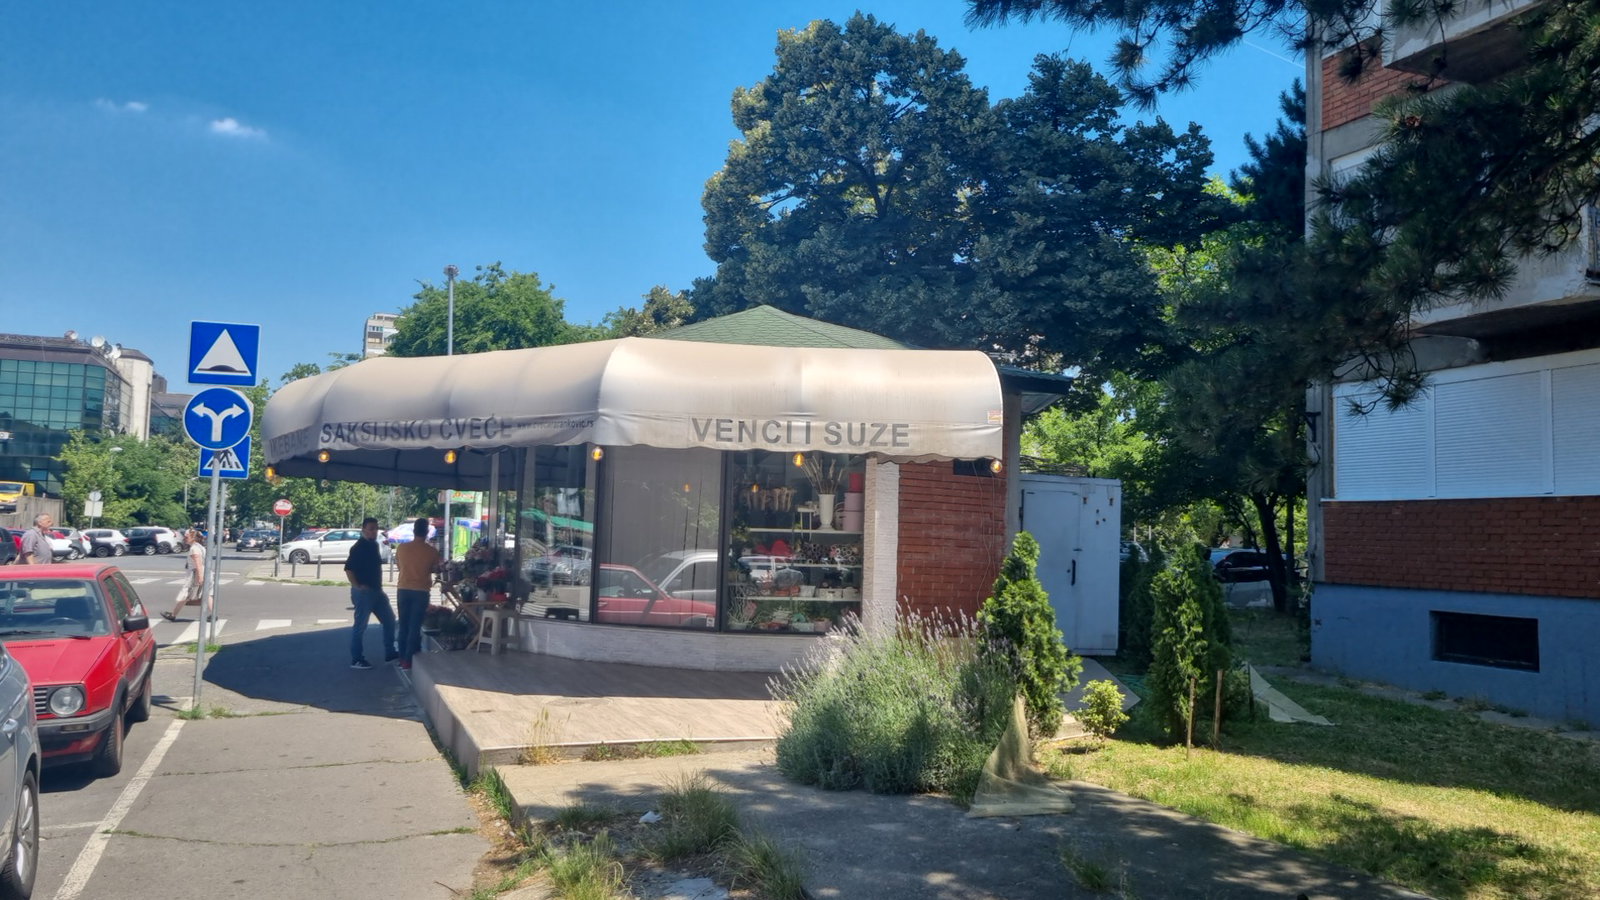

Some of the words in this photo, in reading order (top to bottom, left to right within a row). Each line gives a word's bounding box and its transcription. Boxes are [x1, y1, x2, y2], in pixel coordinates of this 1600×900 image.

[320, 420, 433, 443] SAKSIJSKO
[440, 413, 512, 441] CVEĆE
[691, 418, 792, 444] VENCI
[805, 421, 811, 445] I
[824, 421, 910, 447] SUZE
